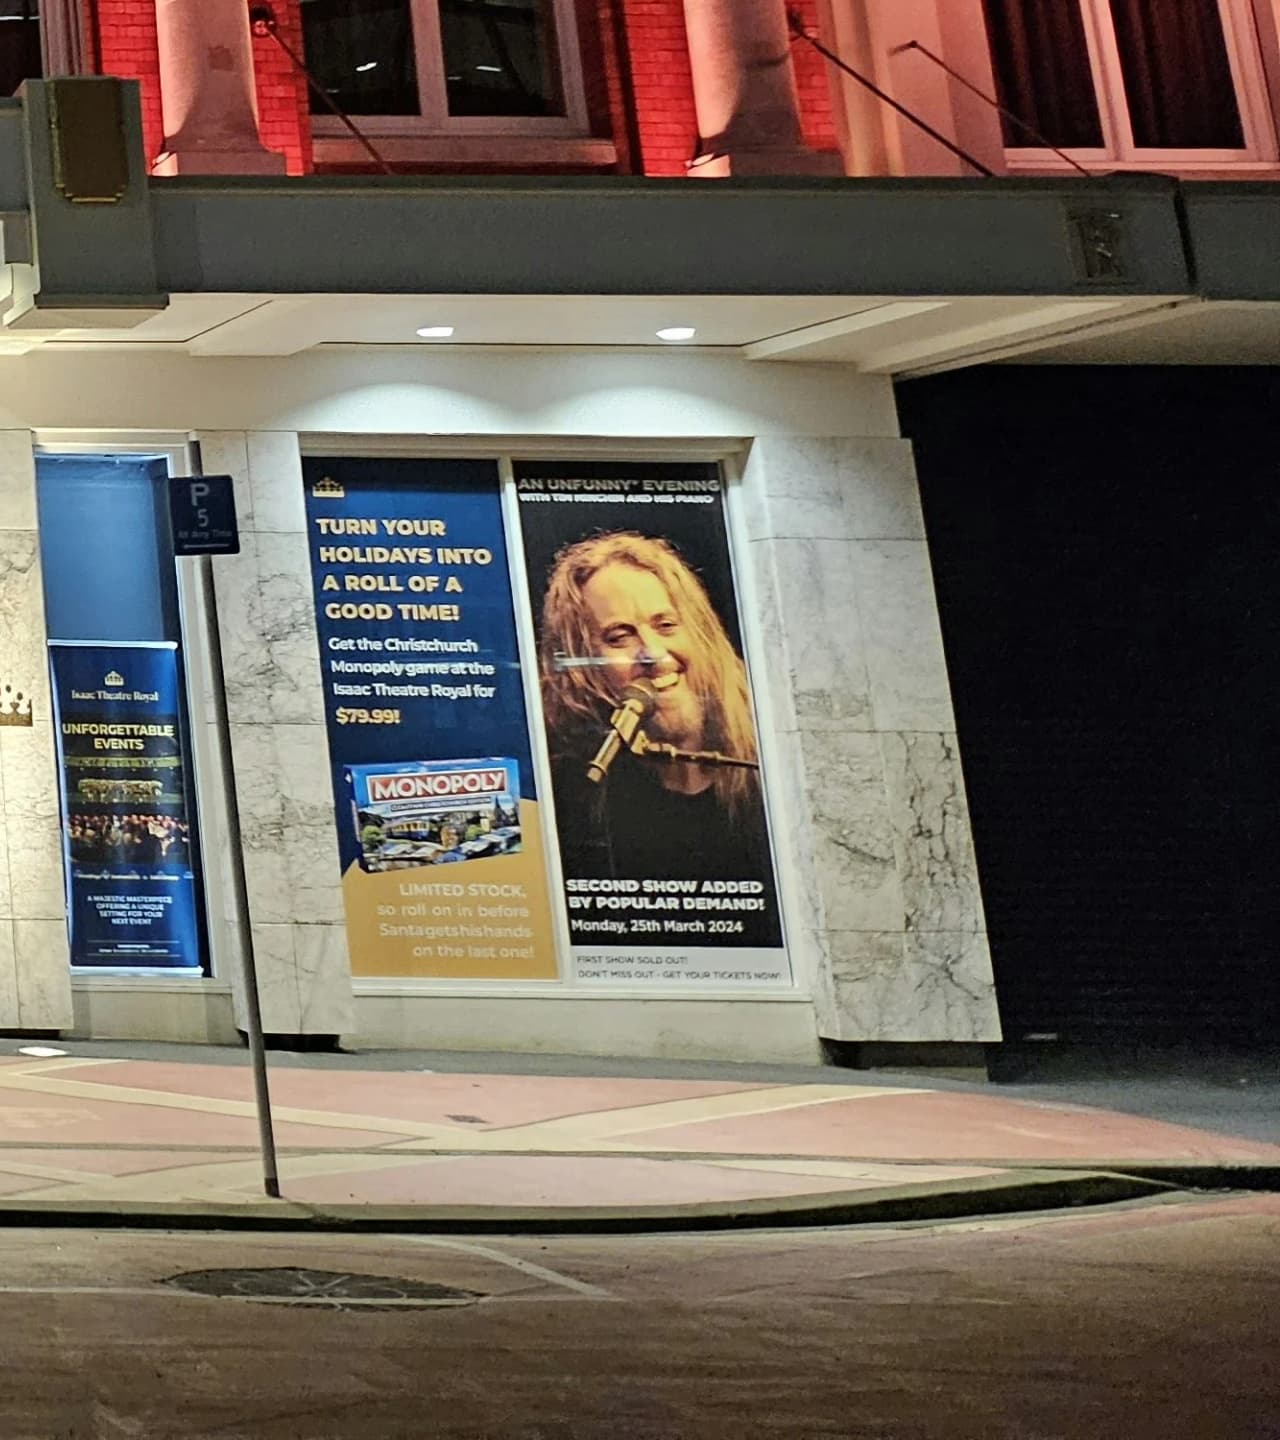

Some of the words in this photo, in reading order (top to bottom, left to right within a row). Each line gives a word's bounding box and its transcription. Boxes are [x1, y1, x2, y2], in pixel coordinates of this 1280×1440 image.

[518, 479, 546, 490] AN
[643, 480, 720, 492] EVENING
[191, 483, 210, 506] P
[197, 508, 209, 528] 5
[315, 518, 377, 535] TURN
[382, 519, 447, 537] YOUR
[319, 547, 432, 564] HOLIDAYS
[437, 548, 493, 565] INTO
[322, 575, 340, 591] A
[345, 575, 403, 592] ROLL
[408, 576, 439, 593] OF
[444, 576, 463, 593] A
[325, 603, 393, 620] GOOD
[397, 604, 460, 621] TIME!
[328, 637, 355, 651] Get
[357, 638, 383, 651] the
[384, 638, 478, 653] Christchurch
[331, 660, 405, 676] Monopoly
[405, 663, 450, 676] game
[450, 663, 468, 675] at
[469, 662, 495, 675] the
[96, 690, 132, 700] Theatre
[133, 691, 159, 703] Royal
[333, 683, 371, 696] Isaac
[372, 683, 429, 697] Theatre
[431, 684, 472, 700] Royal
[473, 684, 496, 698] for
[335, 706, 401, 725] $79.99!
[62, 723, 175, 737] UNFORGETTABLE
[94, 738, 145, 750] EVENTS
[373, 772, 504, 800] MONOPOLY
[399, 883, 465, 896] LIMITED
[566, 879, 640, 892] SECOND
[642, 880, 698, 893] SHOW
[701, 881, 763, 894] ADDED
[376, 904, 395, 916] so
[401, 903, 426, 916] roll
[431, 905, 452, 916] on
[457, 904, 473, 917] in
[478, 904, 529, 917] before
[568, 896, 592, 909] BY
[596, 897, 679, 910] POPULAR
[683, 897, 765, 911] DEMAND!
[379, 923, 424, 937] Santa
[425, 925, 458, 939] gets
[459, 925, 484, 938] his
[485, 925, 533, 938] hands
[571, 919, 628, 934] Monday,
[630, 920, 661, 932] 25th
[664, 920, 706, 933] March
[708, 921, 744, 933] 2024
[413, 946, 433, 957] on
[437, 945, 465, 957] the
[468, 945, 496, 958] last
[499, 945, 535, 958] one!
[605, 956, 635, 964] SHOW
[663, 970, 681, 978] GET
[713, 971, 752, 979] TICKETS
